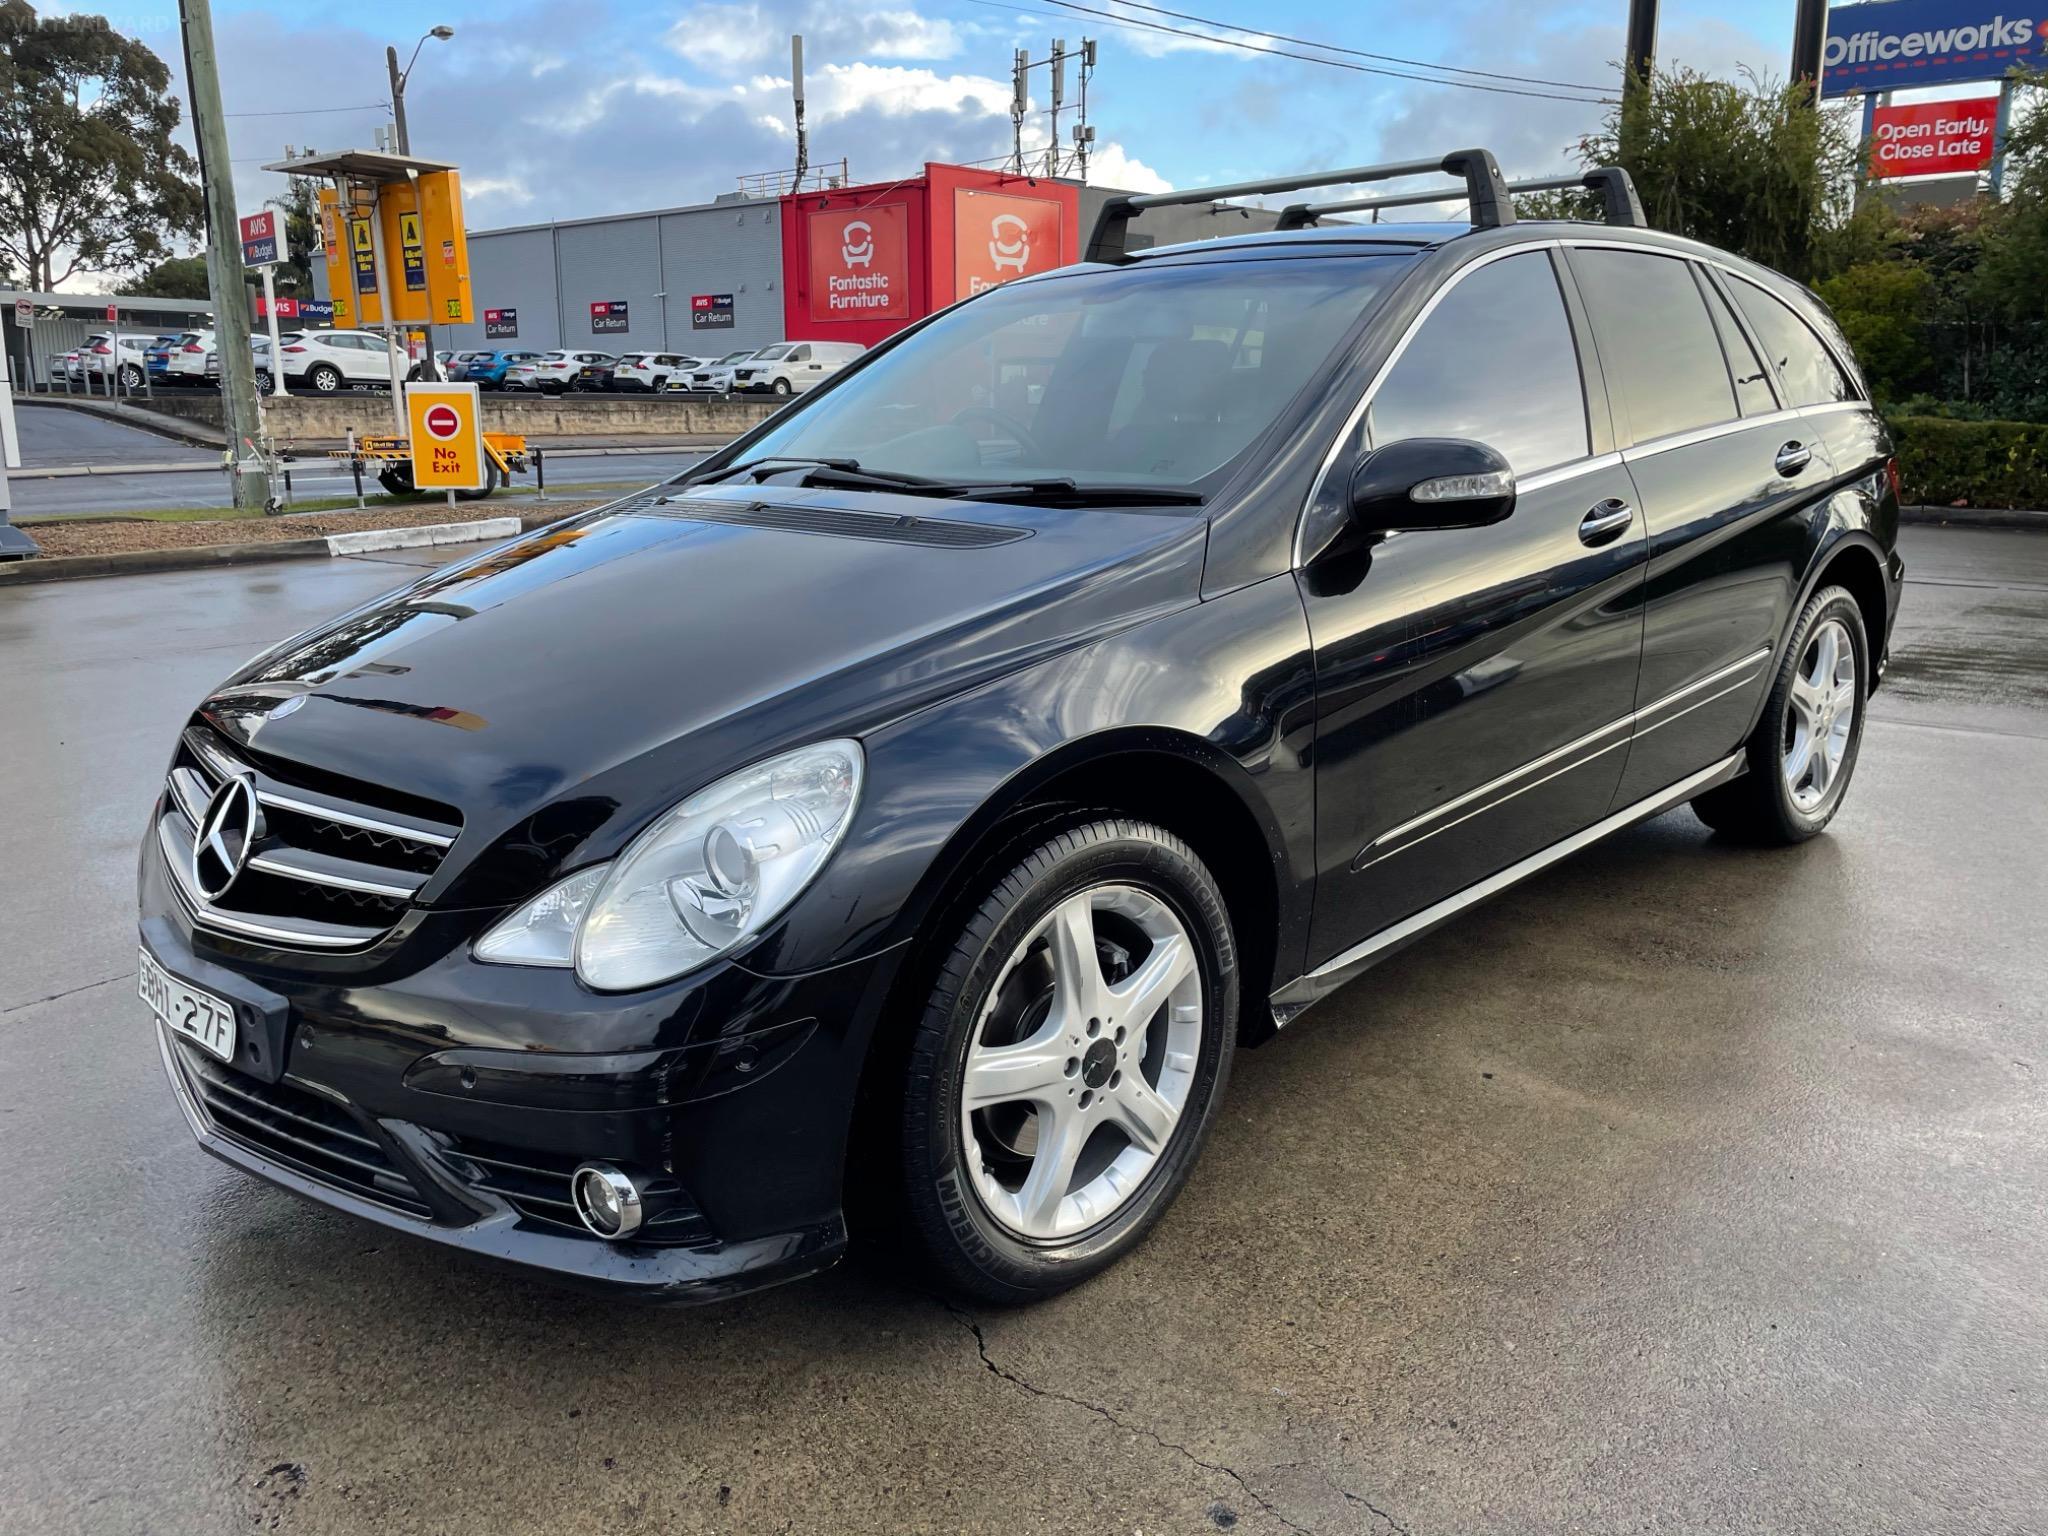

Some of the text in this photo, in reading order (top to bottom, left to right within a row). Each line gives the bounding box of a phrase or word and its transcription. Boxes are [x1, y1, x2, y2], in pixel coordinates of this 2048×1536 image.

[1824, 15, 2033, 67] Officeworks
[1877, 117, 1989, 143] Open Early,
[1879, 139, 1981, 161] Close Late
[250, 217, 267, 237] AVIS
[255, 242, 273, 260] Budget
[829, 272, 889, 292] Fantastic
[266, 302, 290, 313] VIS
[309, 304, 334, 315] Budge
[830, 291, 889, 310] Furniture
[593, 318, 626, 328] Car Return
[694, 312, 731, 323] Car Return
[488, 324, 516, 334] Car Return
[434, 447, 457, 459] No
[432, 461, 461, 473] Exit
